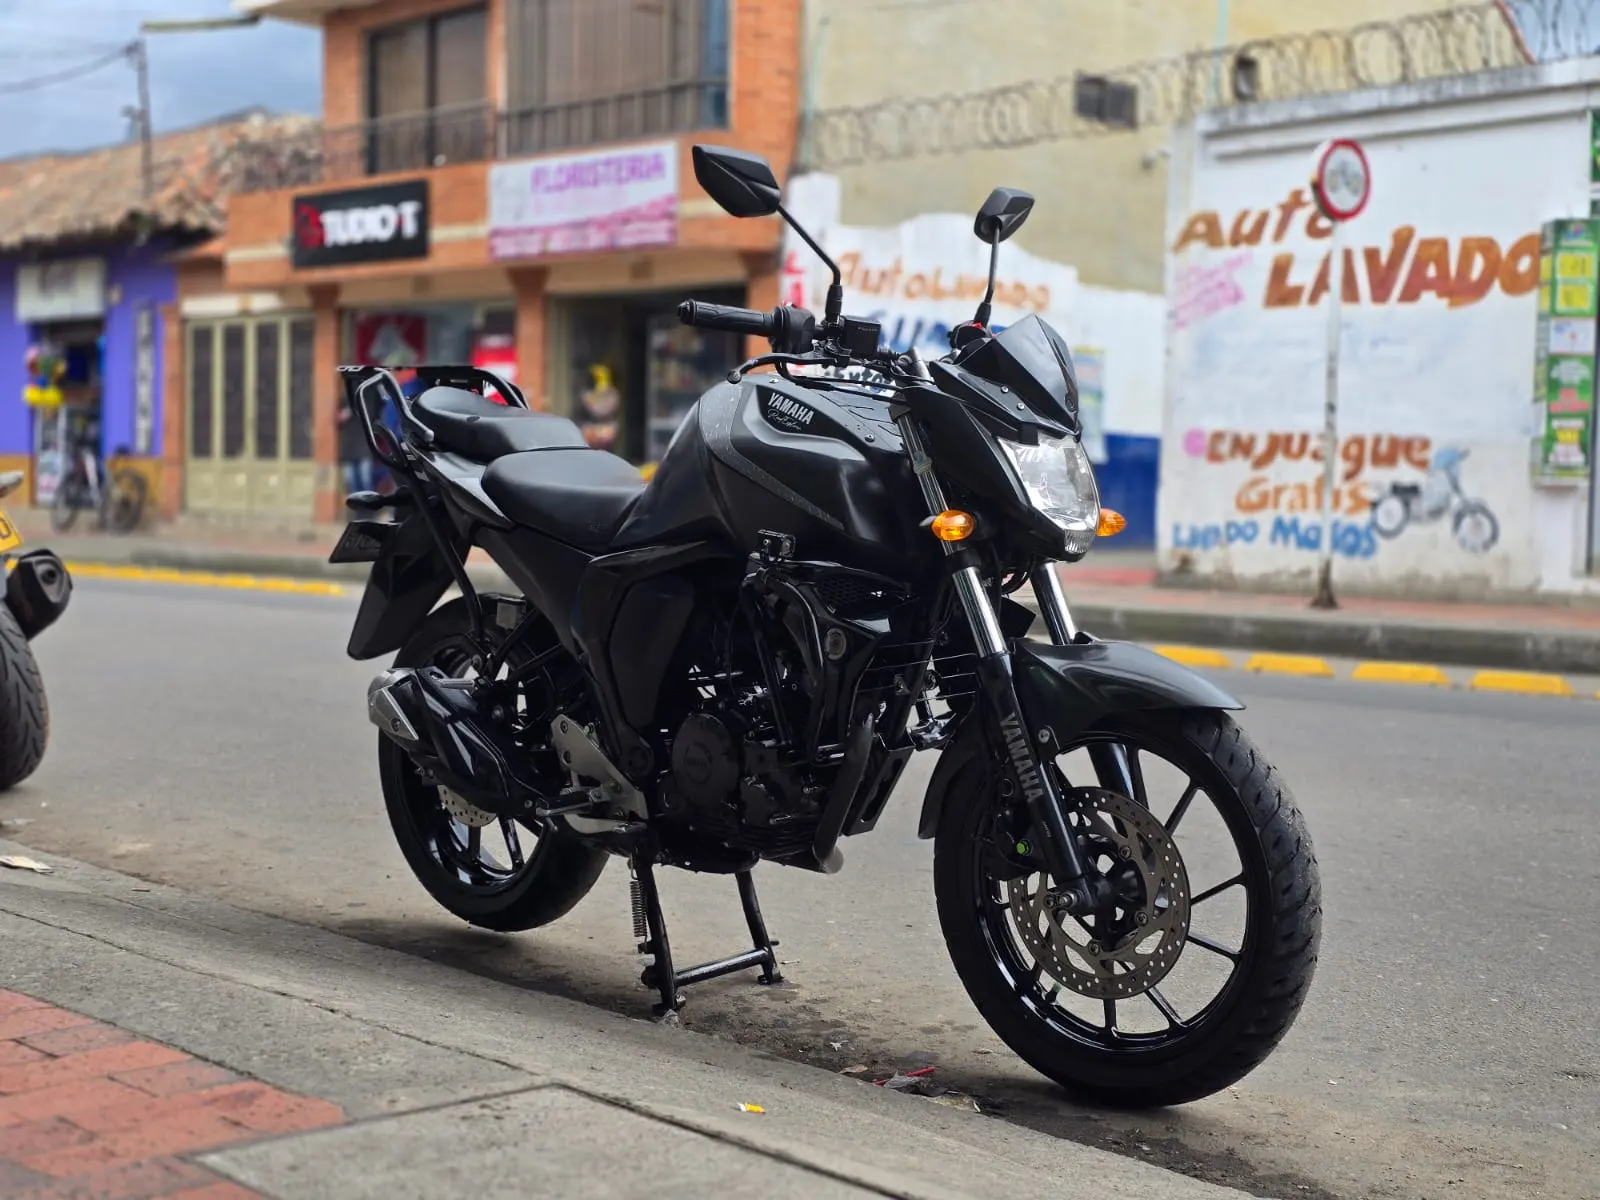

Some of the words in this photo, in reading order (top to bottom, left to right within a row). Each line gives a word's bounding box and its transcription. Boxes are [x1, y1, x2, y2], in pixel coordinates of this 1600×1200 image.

[1263, 225, 1541, 310] LAVADO
[768, 392, 815, 425] YAMAHA
[1000, 711, 1044, 803] YAMAHA
